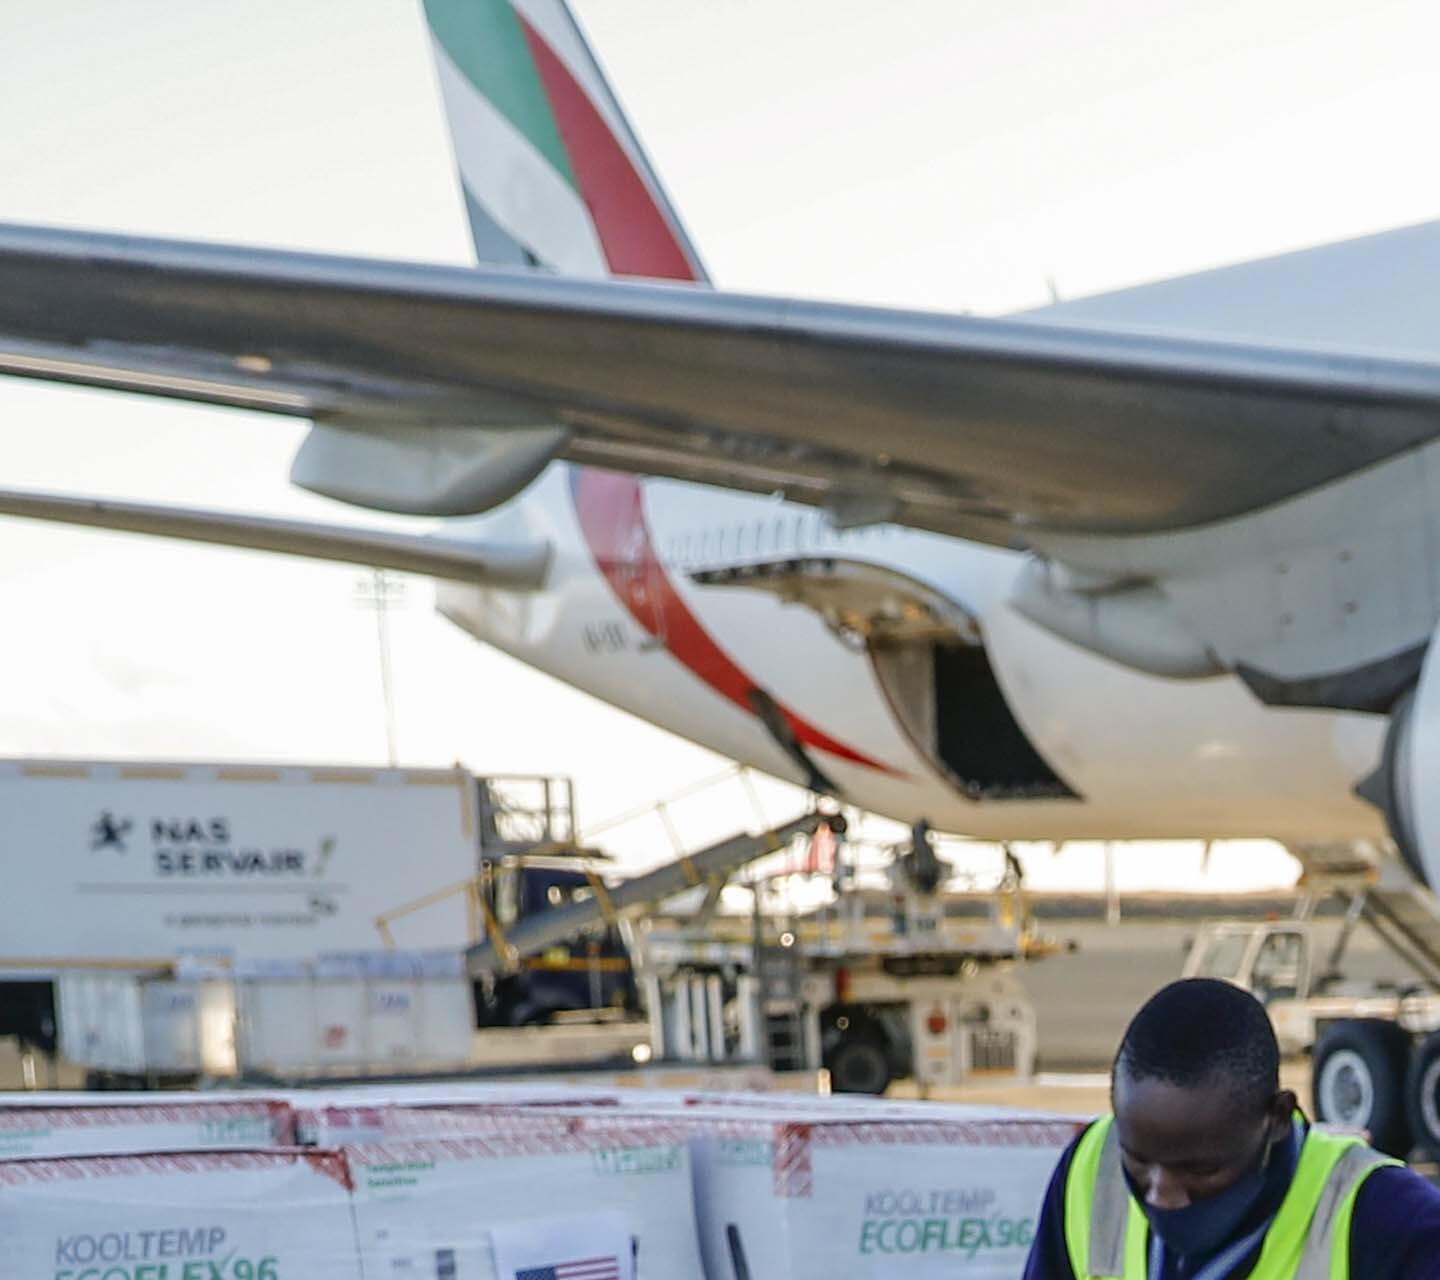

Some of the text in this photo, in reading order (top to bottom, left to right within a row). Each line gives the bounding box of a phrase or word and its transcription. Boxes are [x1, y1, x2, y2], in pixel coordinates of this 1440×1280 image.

[152, 816, 232, 844] NAS
[155, 849, 306, 877] SERVAIR
[55, 1226, 227, 1266] KOOLTEMP
